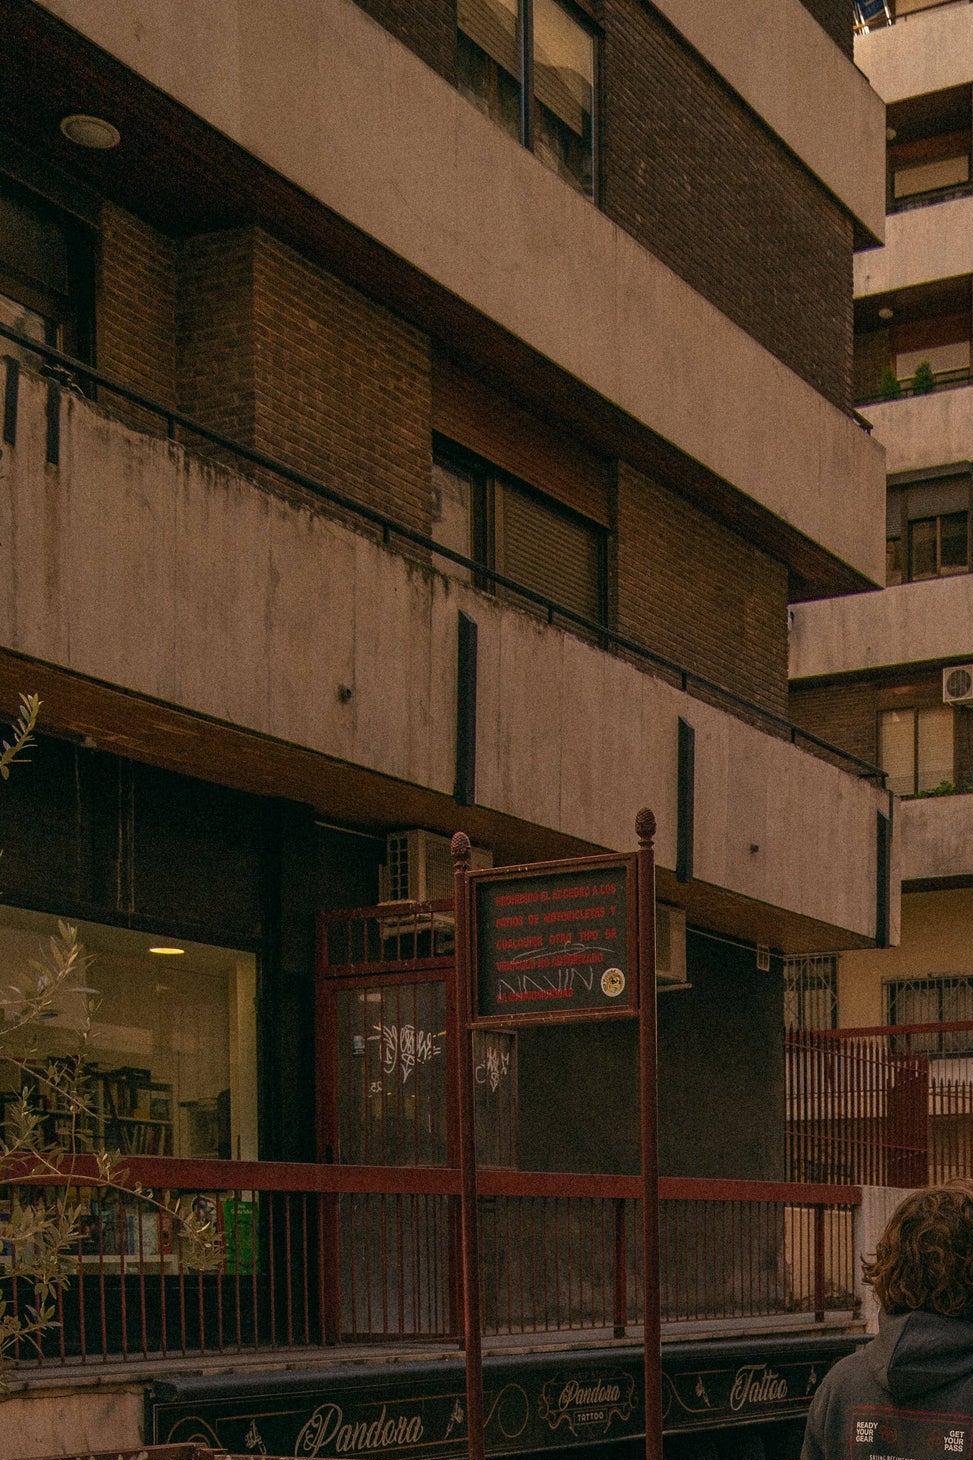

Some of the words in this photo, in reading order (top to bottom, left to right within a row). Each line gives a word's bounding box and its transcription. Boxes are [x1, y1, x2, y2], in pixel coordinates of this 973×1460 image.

[528, 914, 538, 924] DE
[496, 936, 543, 950] CUALQUIER
[550, 933, 572, 944] OTRO
[579, 930, 598, 942] TIPO
[605, 928, 616, 939] DE
[558, 1379, 620, 1410] Pandora
[730, 1363, 788, 1411] Tattoo
[577, 1412, 604, 1422] TATTOO
[295, 1403, 424, 1457] Pandora
[944, 1437, 964, 1445] YOUR
[944, 1444, 964, 1452] PASS
